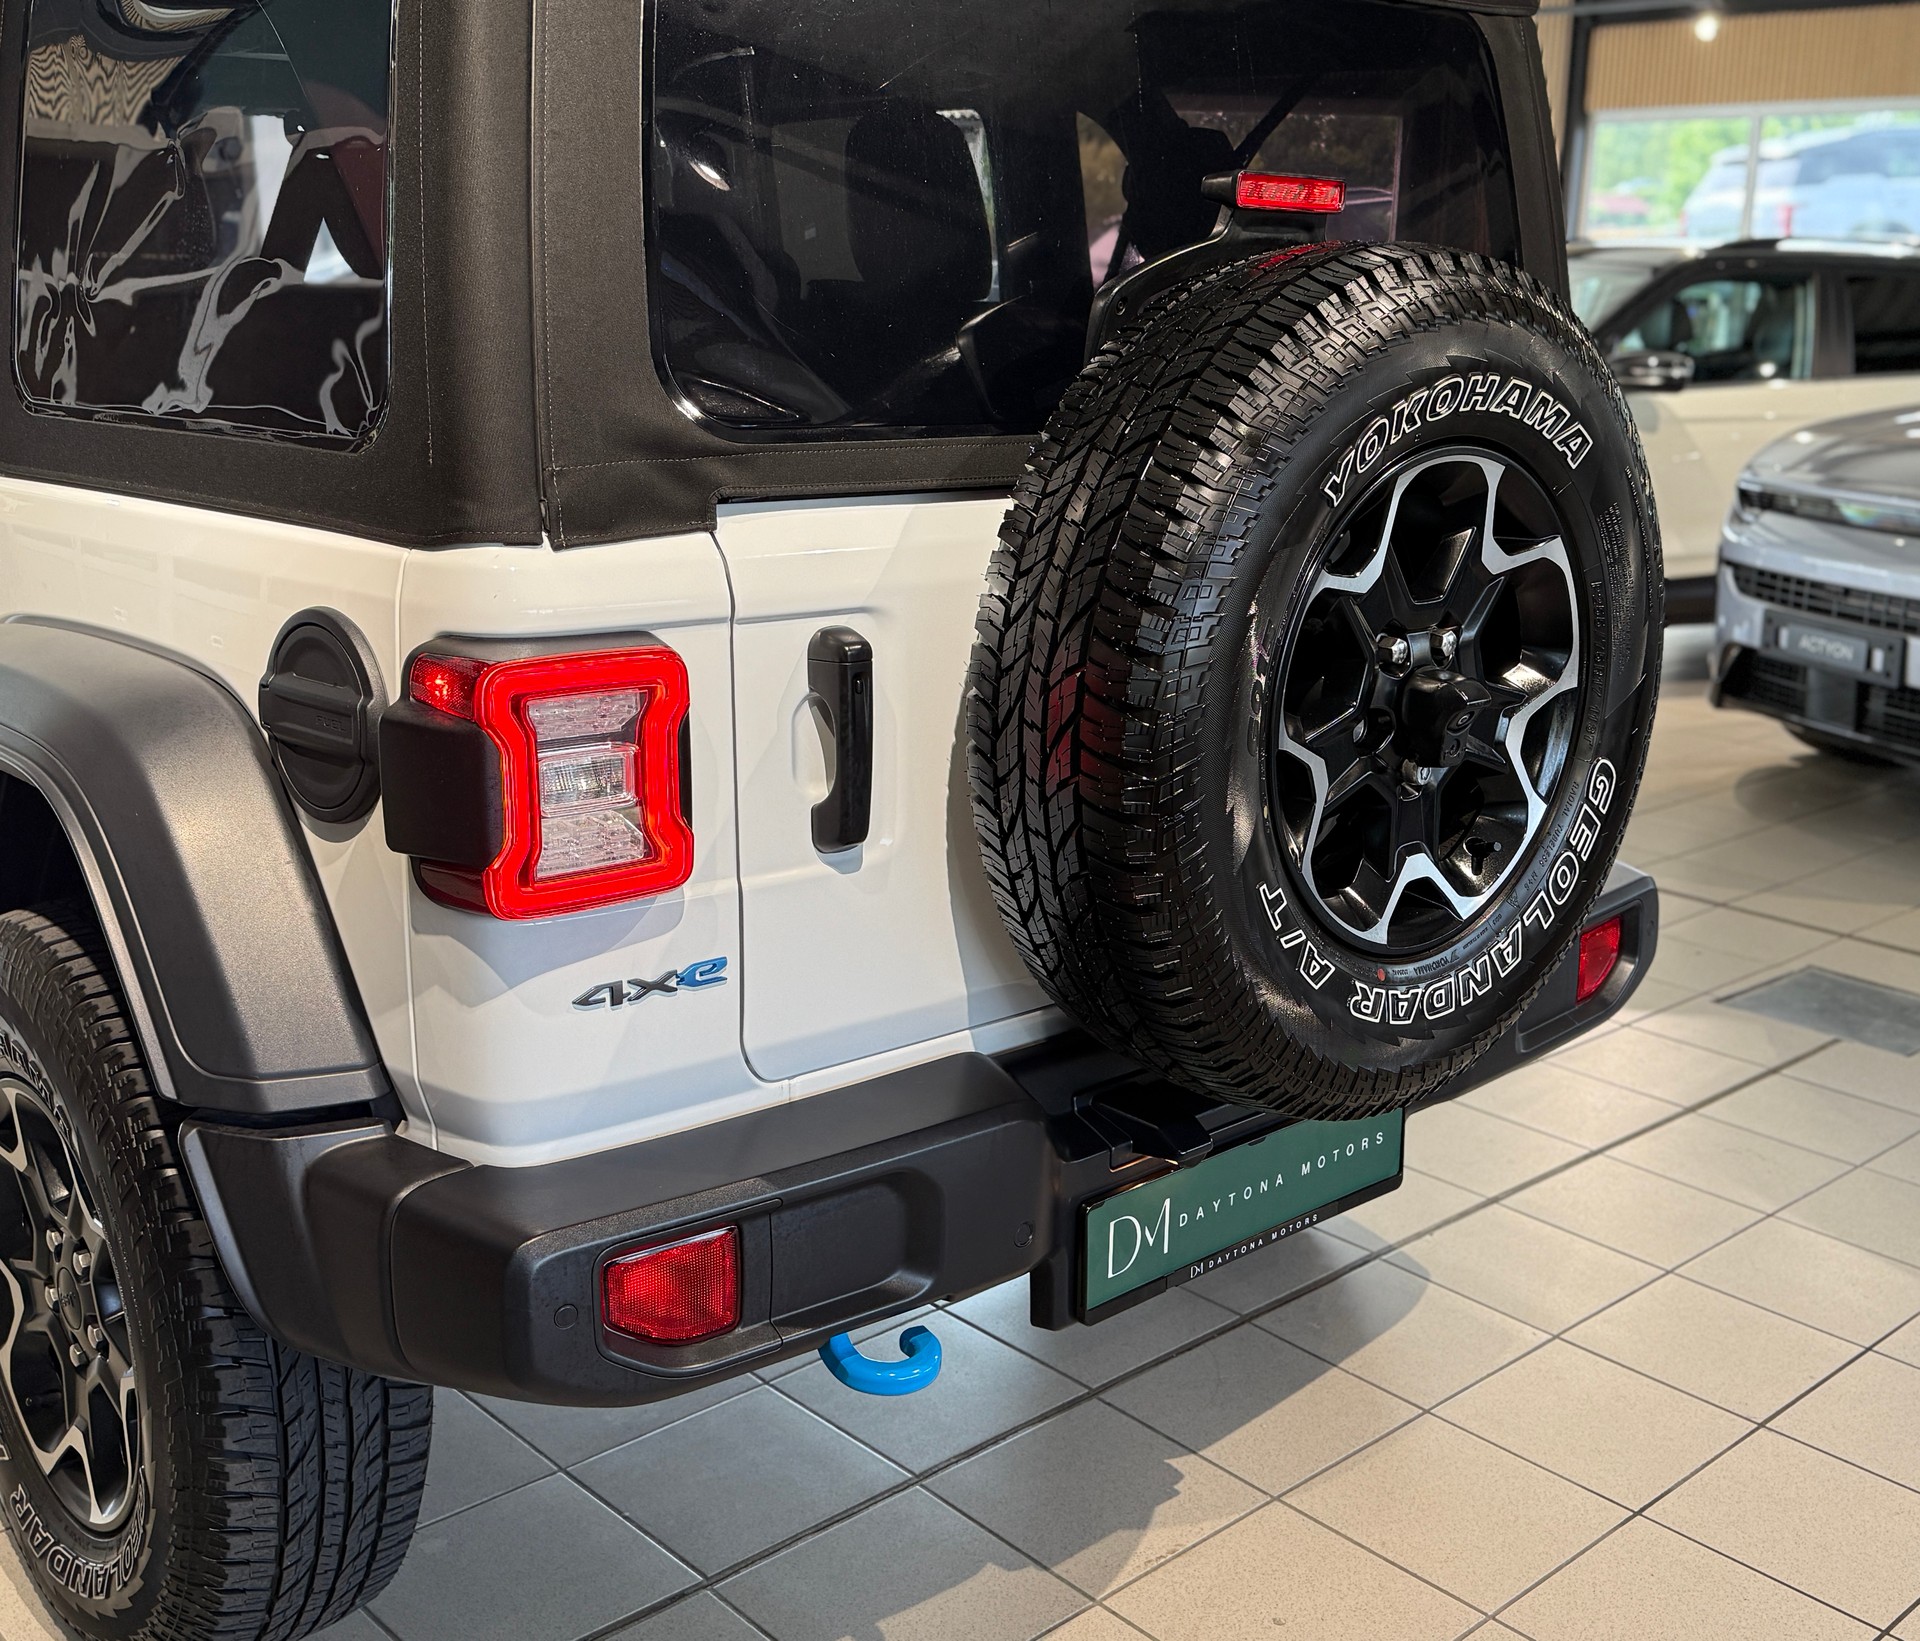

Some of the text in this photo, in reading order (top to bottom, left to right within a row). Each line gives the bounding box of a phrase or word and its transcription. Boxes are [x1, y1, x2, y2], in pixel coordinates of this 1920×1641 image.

[1321, 373, 1594, 506] YOKOHAMA
[1349, 756, 1617, 1025] GEOLANDAR
[1179, 1173, 1284, 1227] DAYTONA
[1301, 1131, 1385, 1176] MOTORS
[1208, 1238, 1263, 1268] DAYTONA
[1271, 1213, 1318, 1240] MOTORS
